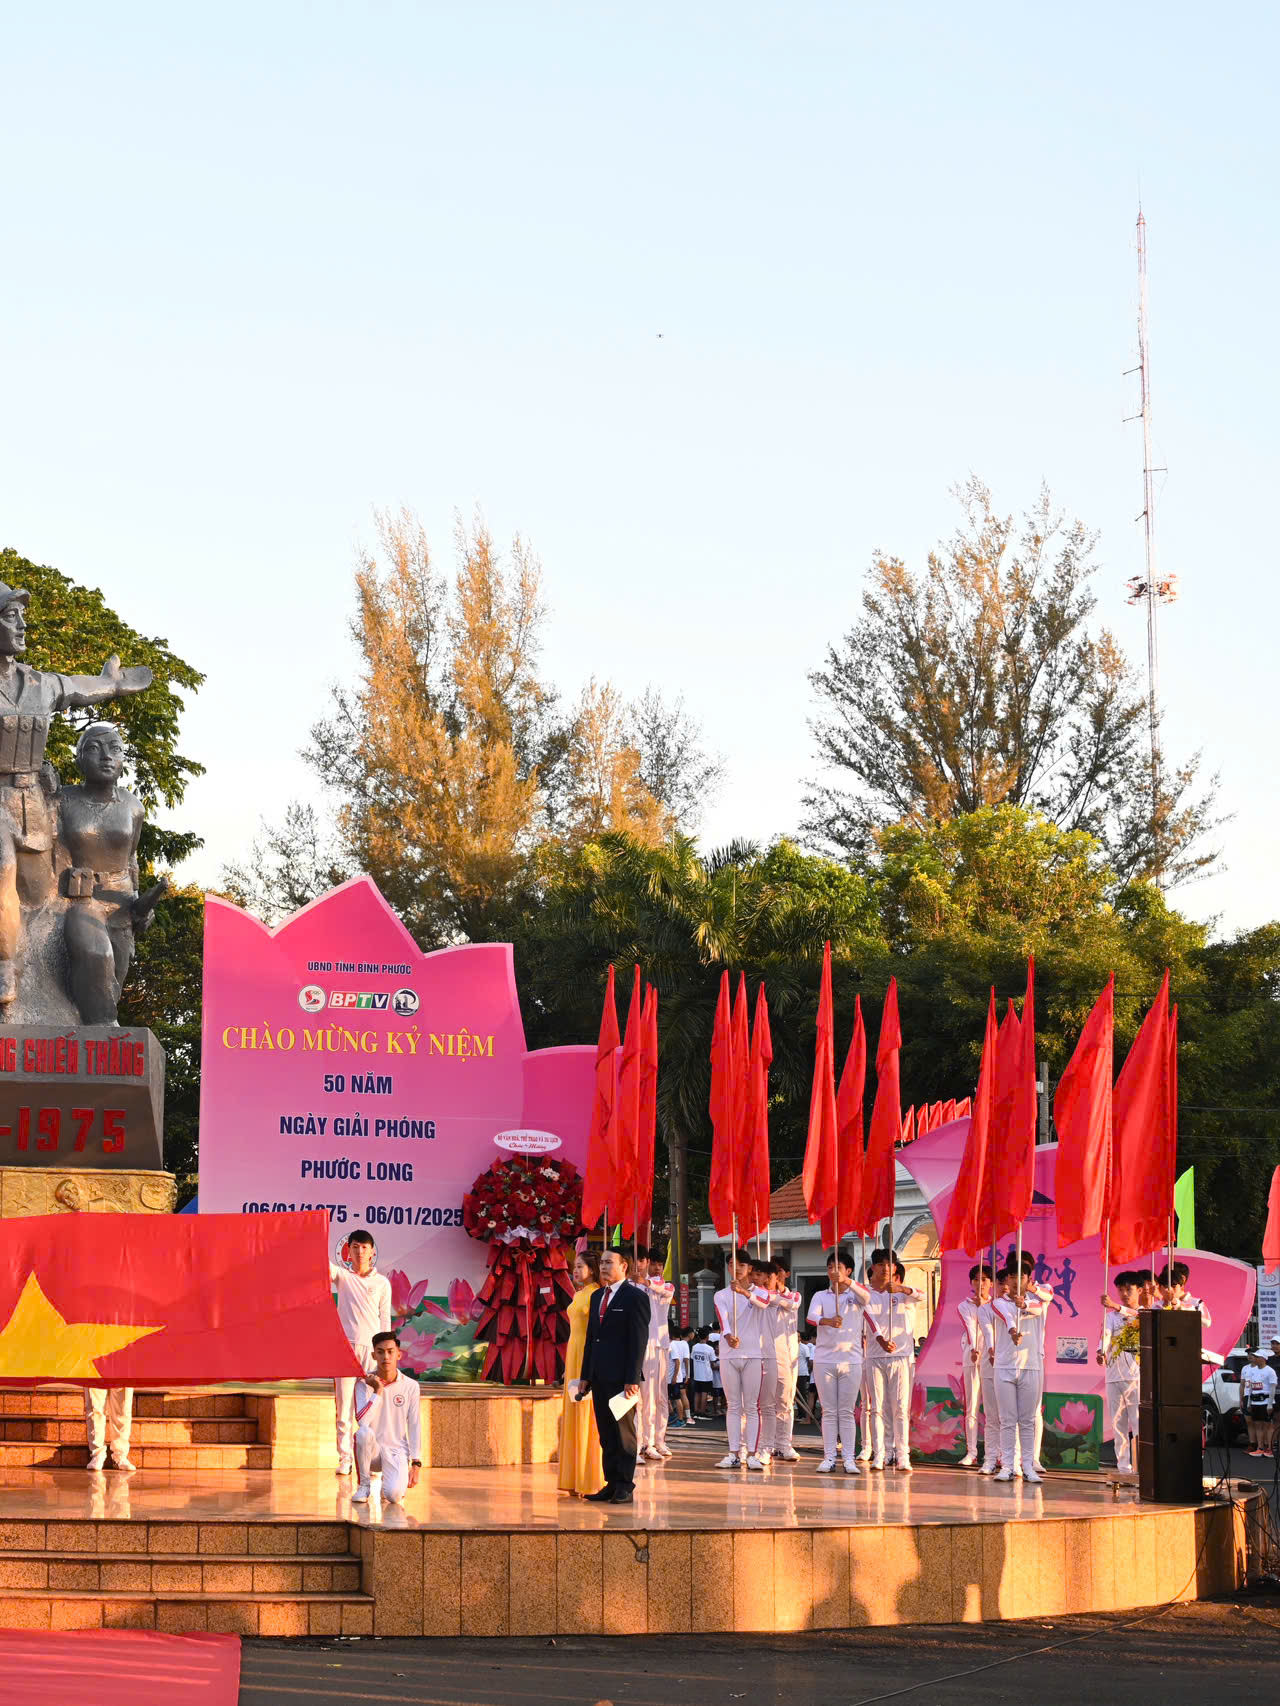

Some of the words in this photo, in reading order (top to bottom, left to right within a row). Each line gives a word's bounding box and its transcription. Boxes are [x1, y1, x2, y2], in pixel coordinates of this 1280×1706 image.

[308, 962, 332, 971] UBND
[335, 960, 355, 972] TỈNH
[358, 961, 379, 973] BÌNH
[381, 963, 412, 974] PHƯỚC
[331, 993, 389, 1009] BPTV
[222, 1021, 295, 1051] CHÀO
[302, 1026, 377, 1053] MỪNG
[386, 1026, 422, 1056] KỶ
[429, 1028, 494, 1062] NIỆM
[24, 1031, 79, 1074] CHIẾN
[86, 1032, 145, 1077] THẮNG
[324, 1075, 345, 1093] 50
[351, 1071, 392, 1094] NĂM
[280, 1114, 328, 1136] NGÀY
[334, 1112, 368, 1137] GIẢI
[375, 1115, 436, 1139] PHÓNG
[301, 1157, 361, 1180] PHƯỚC
[367, 1162, 413, 1181] LONG
[242, 1202, 347, 1223] (06/75
